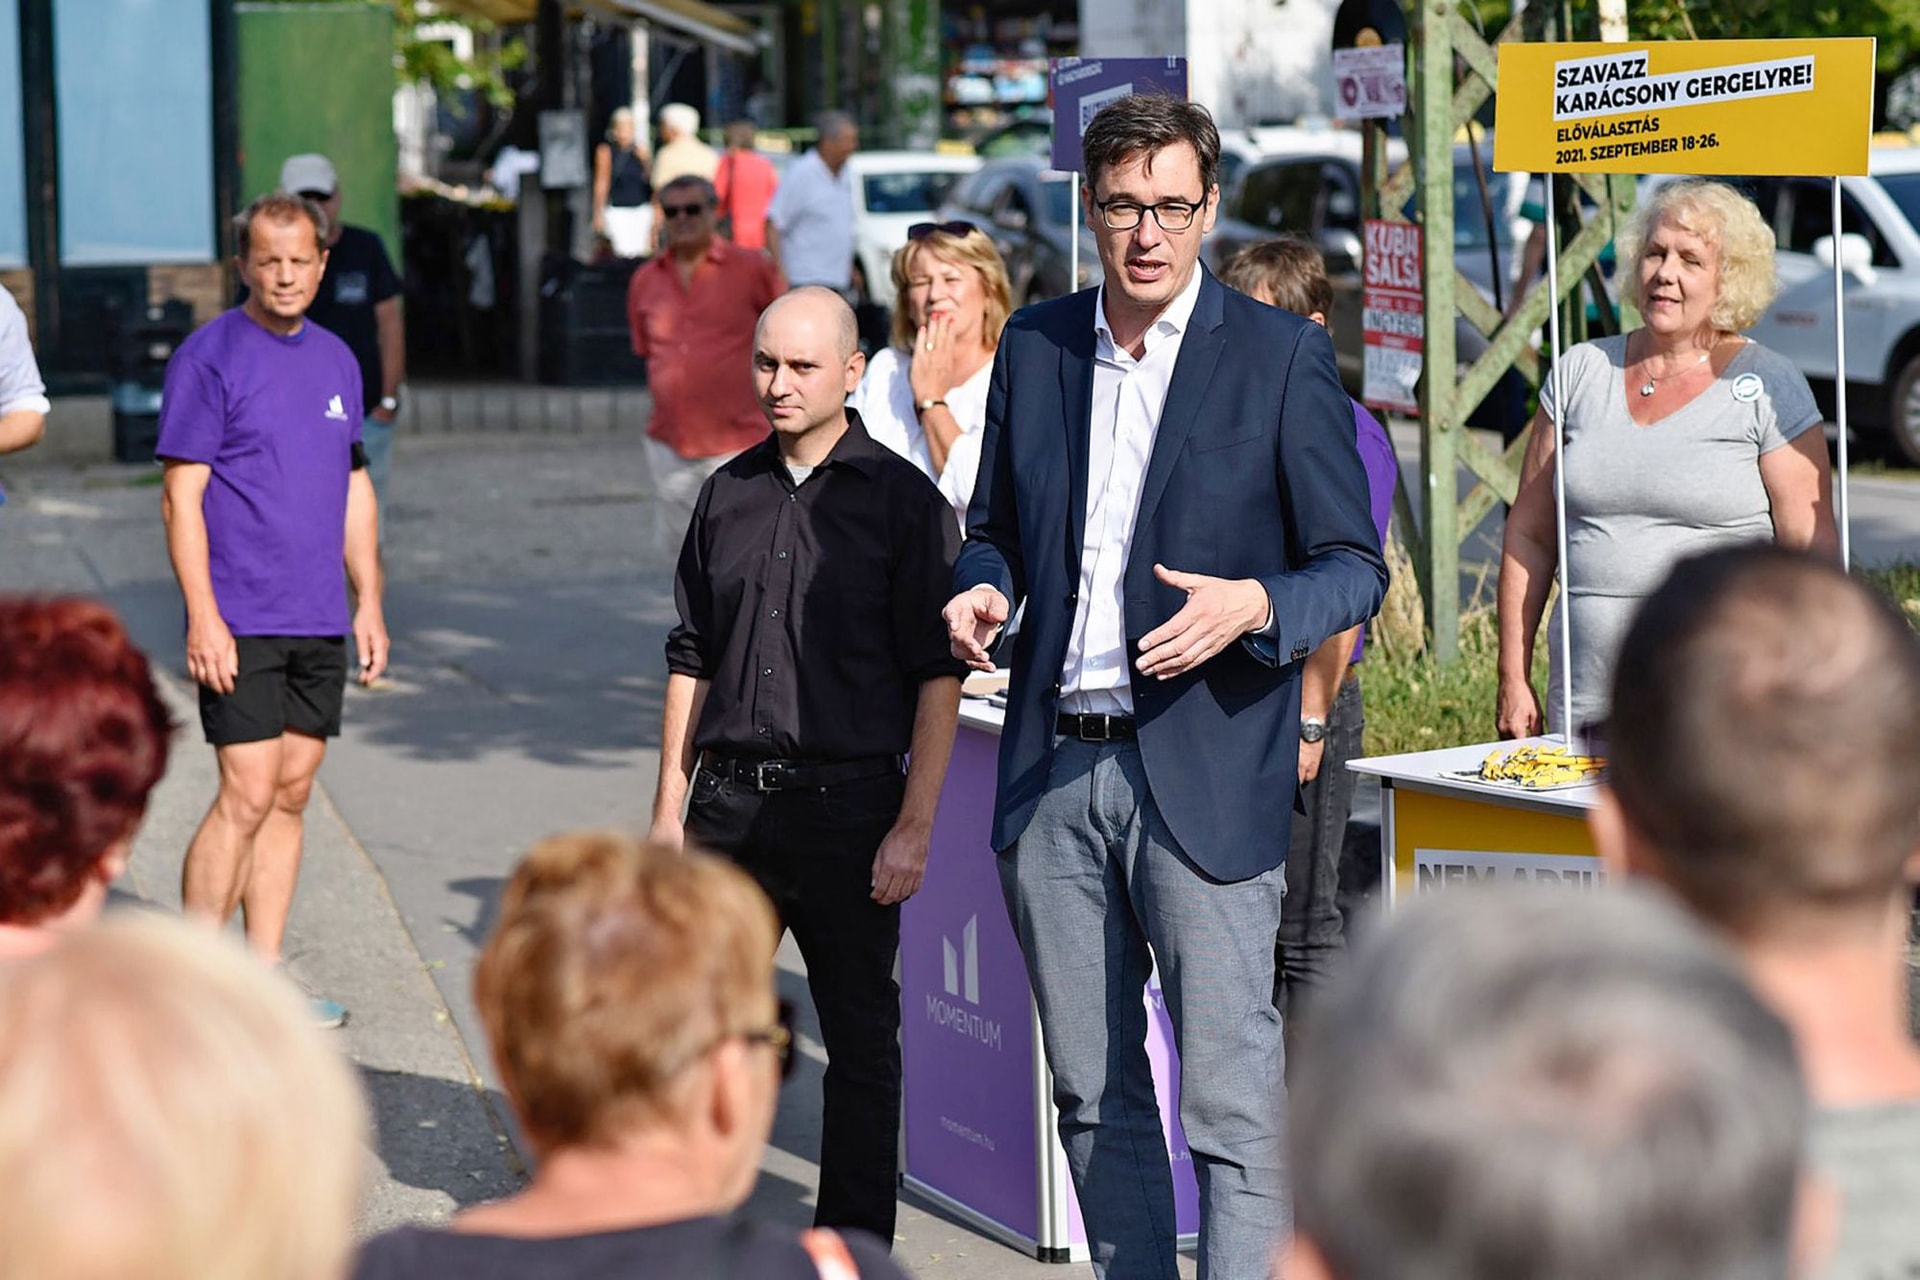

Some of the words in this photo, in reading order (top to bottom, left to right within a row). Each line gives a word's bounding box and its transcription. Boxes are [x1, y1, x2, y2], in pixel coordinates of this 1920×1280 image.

[1556, 58, 1646, 88] SZAVAZZ
[1556, 81, 1680, 115] KARÁCSONY
[1685, 64, 1812, 98] GERGELYRE!
[1556, 115, 1660, 142] ELŐVÁLASZTÁS
[1556, 148, 1587, 164] 2021.
[1590, 138, 1678, 160] SZEPTEMBER
[1681, 133, 1720, 150] 18-26.
[926, 992, 1002, 1052] MOMENTUM
